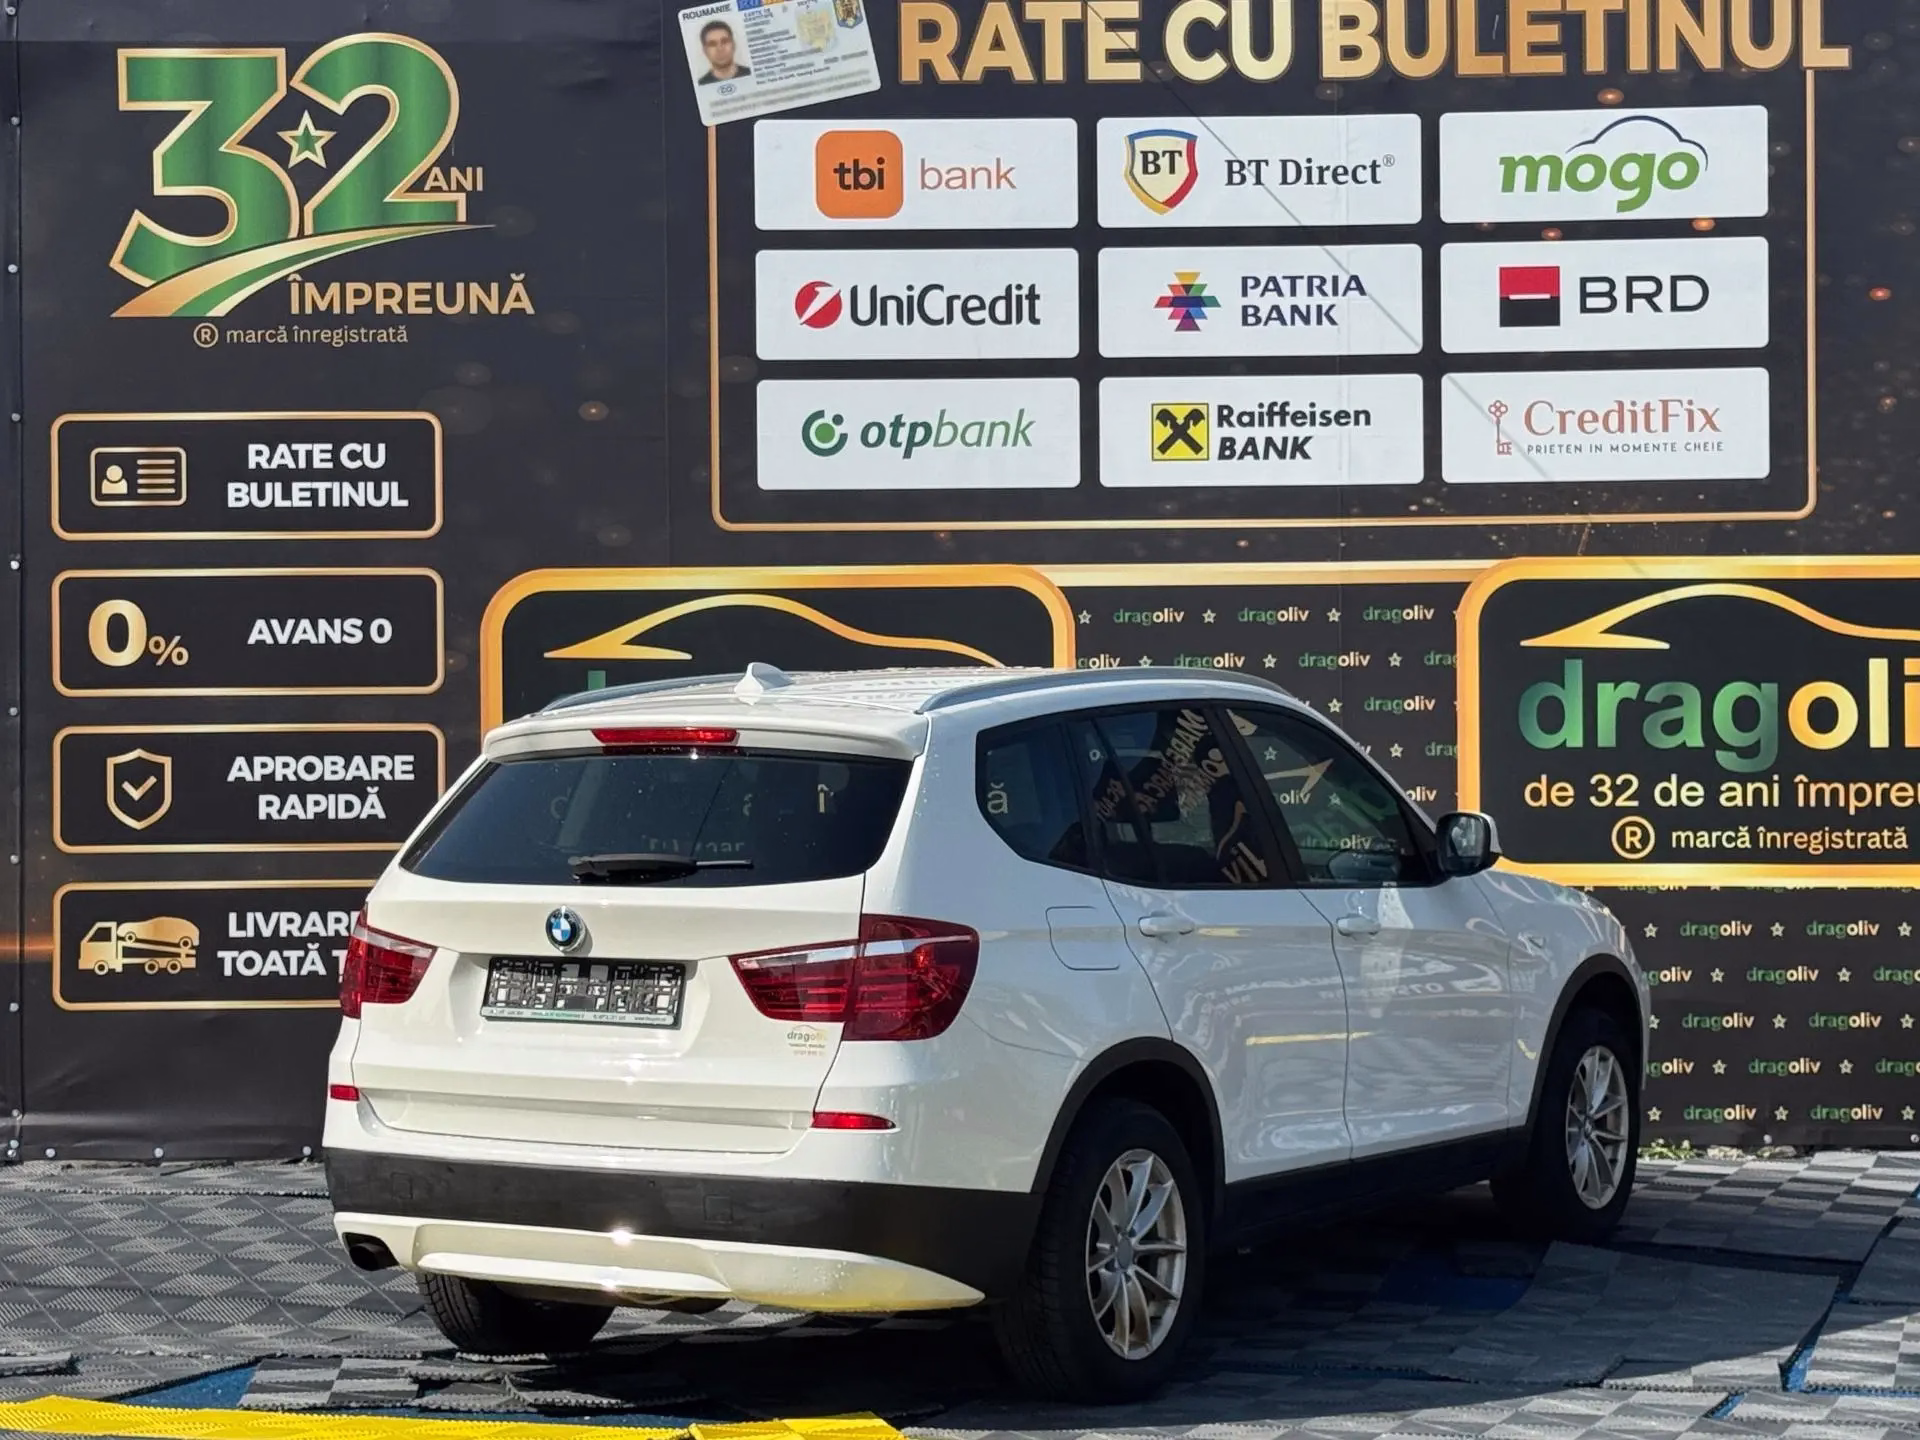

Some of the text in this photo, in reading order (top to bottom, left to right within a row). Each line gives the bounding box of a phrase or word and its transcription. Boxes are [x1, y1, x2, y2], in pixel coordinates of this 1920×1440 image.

[682, 4, 732, 21] ROUMANIE
[899, 0, 1852, 83] RATE CU BULETINUL
[110, 32, 484, 287] 32 ANI
[1140, 149, 1183, 176] BT
[1224, 158, 1269, 187] BT
[833, 158, 1017, 191] tbi bank
[1500, 151, 1700, 213] mogo
[288, 272, 535, 315] ÎMPREUNĂ
[1241, 274, 1367, 297] PATRIA
[1579, 274, 1710, 314] BRD
[849, 283, 1041, 327] UniCredit
[1241, 304, 1339, 327] BANK
[226, 325, 288, 344] marcă
[293, 324, 408, 345] înregistrată
[1217, 402, 1371, 428] Raiffeisen
[1523, 398, 1723, 436] CreditFix
[247, 443, 387, 470] RATE CU
[1217, 436, 1314, 461] BANK
[1526, 442, 1724, 455] PRIETEN IN MOMENTE CHEIE
[227, 481, 409, 508] BULETINUL
[1113, 607, 1185, 626] dragoliv
[1237, 606, 1310, 625] dragoliv
[1362, 604, 1435, 624] dragoliv
[247, 618, 393, 645] AVANS 0
[1298, 651, 1371, 670] dragoliv
[1364, 695, 1436, 714] dragoliv
[1518, 657, 1920, 773] dragoli
[226, 755, 415, 782] APROBARE
[258, 786, 386, 820] RAPIDĂ
[1524, 774, 1920, 816] de 32 de ani împre
[1671, 826, 1752, 850] marcă
[1757, 826, 1909, 855] înregistrată
[1680, 921, 1753, 940] dragoliv
[1806, 920, 1880, 939] dragoliv
[217, 943, 327, 976] TOATĂ
[1747, 966, 1819, 985] dragoliv
[1681, 1012, 1755, 1032] dragoliv
[1808, 1012, 1882, 1031] dragoliv
[1748, 1057, 1822, 1077] dragoliv
[1683, 1104, 1756, 1123] dragoliv
[1810, 1104, 1883, 1123] dragoliv
